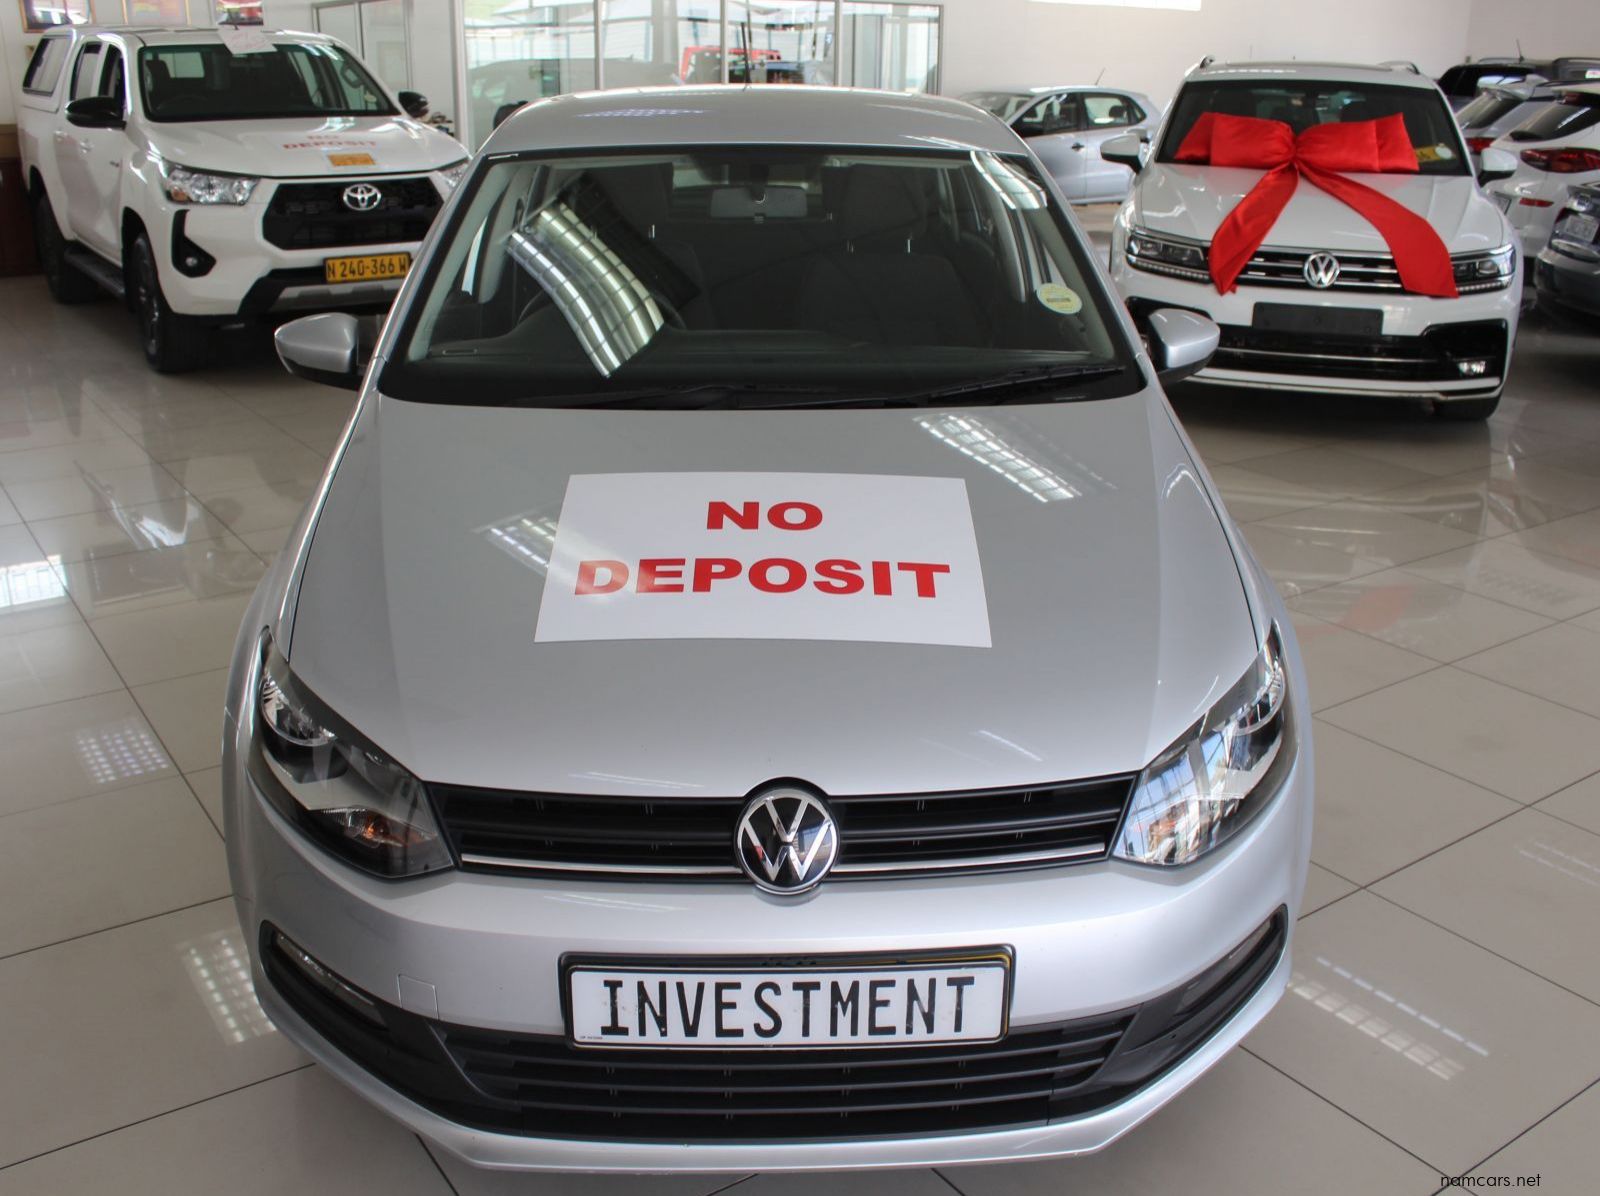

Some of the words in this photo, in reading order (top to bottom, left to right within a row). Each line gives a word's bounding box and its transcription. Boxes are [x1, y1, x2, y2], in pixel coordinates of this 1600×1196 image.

[327, 262, 335, 278] N
[706, 501, 823, 531] NO
[575, 557, 951, 598] DEPOSIT
[600, 976, 976, 1039] INVESTMENT
